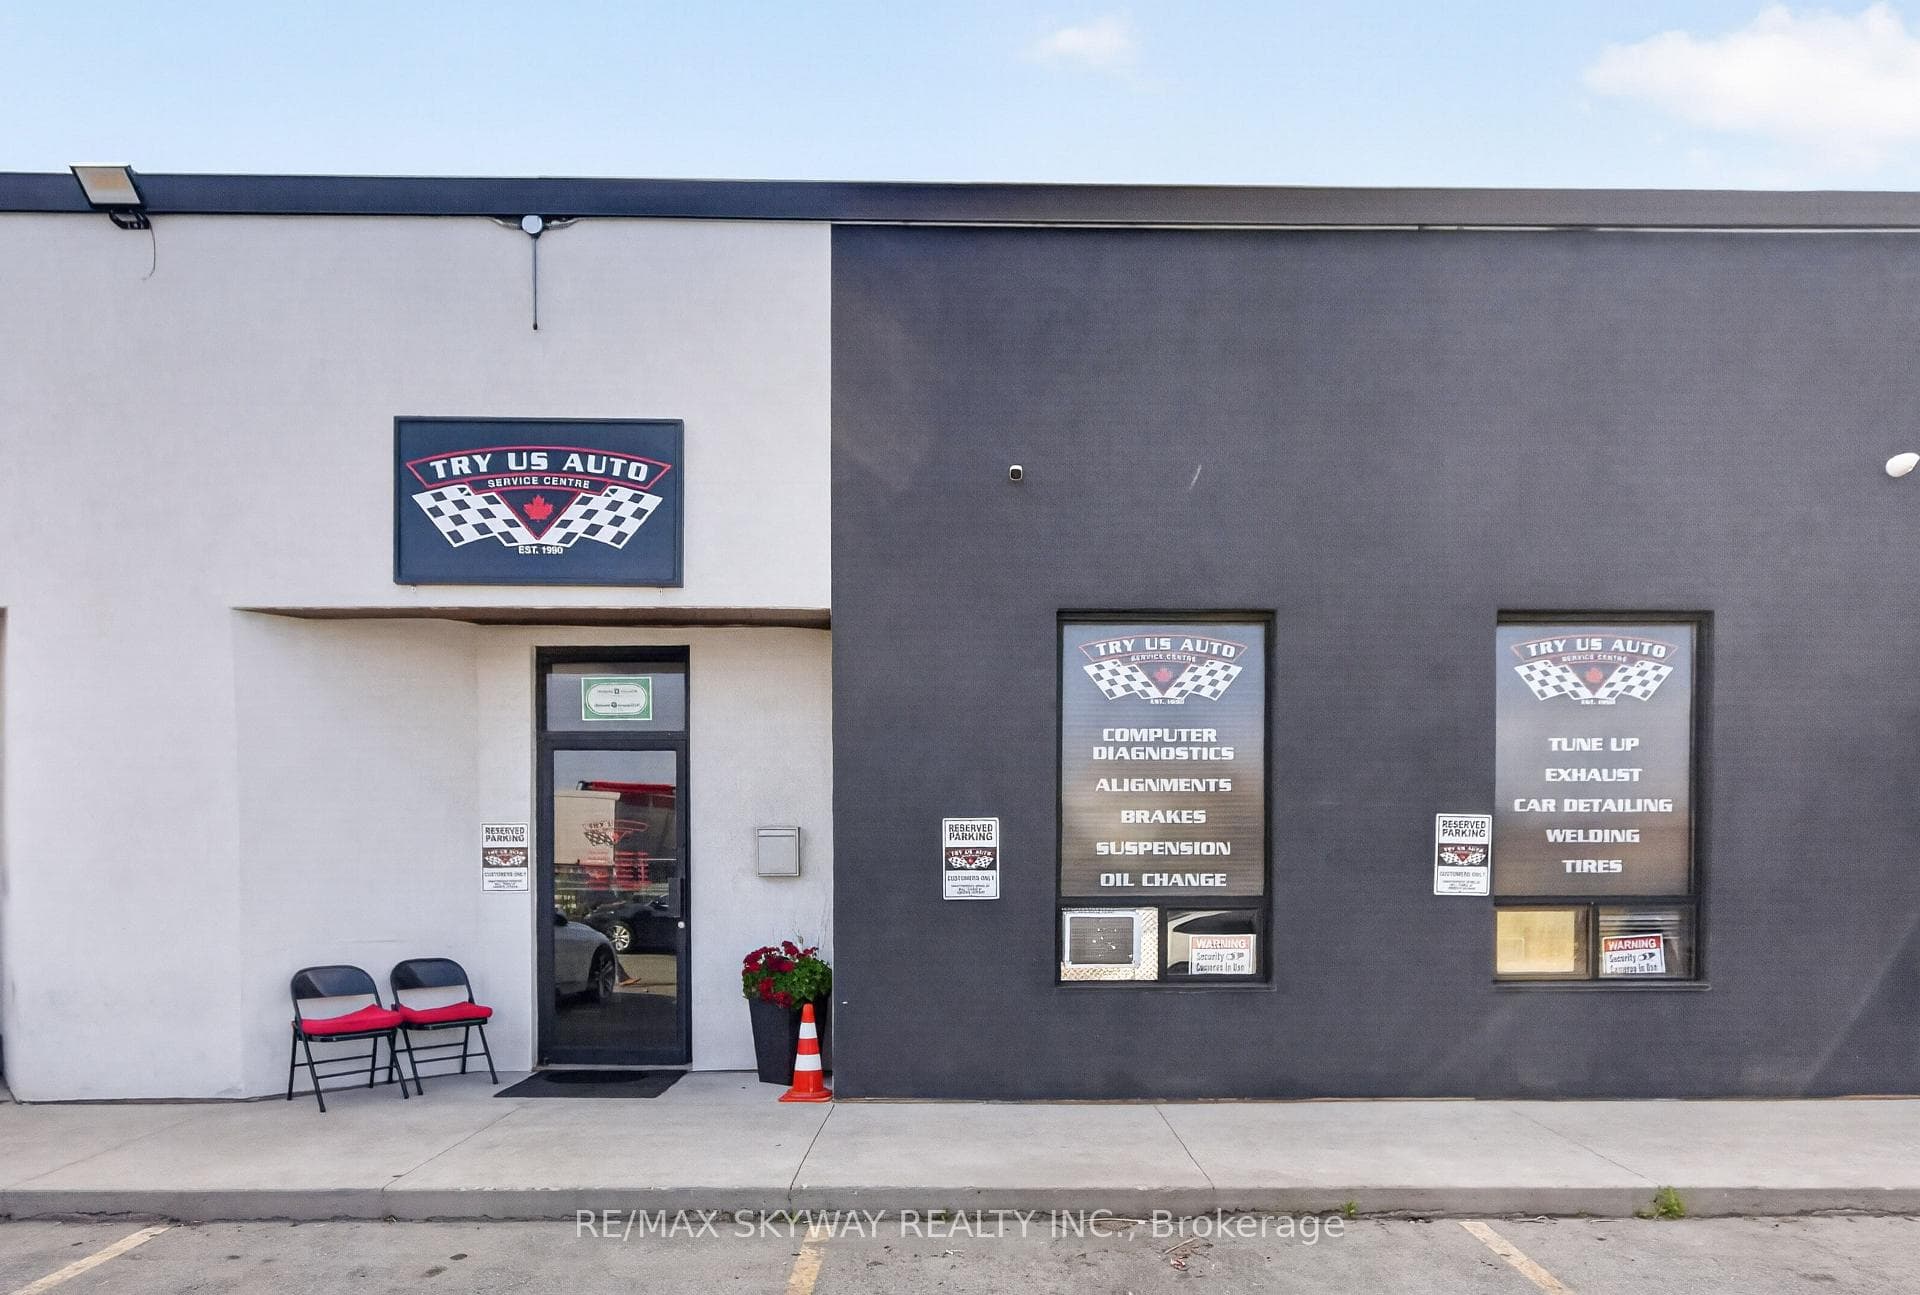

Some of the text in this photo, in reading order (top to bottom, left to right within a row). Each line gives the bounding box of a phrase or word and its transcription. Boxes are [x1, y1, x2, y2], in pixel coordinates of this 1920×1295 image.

[429, 451, 649, 482] TRY US AUTO
[487, 476, 590, 489] SERVICE CENTRE
[518, 545, 564, 554] EST. 1990
[1095, 637, 1236, 658] TRY US AUTO
[1526, 637, 1667, 658] TRY US AUTO
[1102, 728, 1217, 743] COMPUTER
[1547, 738, 1640, 751] TUNE UP
[1093, 746, 1235, 761] DIAGNOSTICS
[1545, 768, 1643, 782] EXHAUST
[1095, 778, 1232, 792] ALIGNMENTS
[1513, 798, 1673, 813] CAR DETAILING
[1120, 809, 1206, 824] BRAKES
[485, 826, 524, 835] RESERVED
[948, 824, 993, 832] RESERVED
[1442, 820, 1486, 829] RESERVED
[949, 832, 993, 841] PARKING
[1442, 829, 1486, 837] PARKING
[1546, 829, 1640, 843] WELDING
[1096, 841, 1231, 856] SUSPENSION
[1561, 859, 1623, 873] TIRES
[1100, 873, 1227, 887] OIL CHANGE
[1196, 938, 1247, 949] WARNING
[1608, 938, 1657, 950] WARNING
[1196, 951, 1224, 963] Security
[1609, 953, 1637, 963] Security
